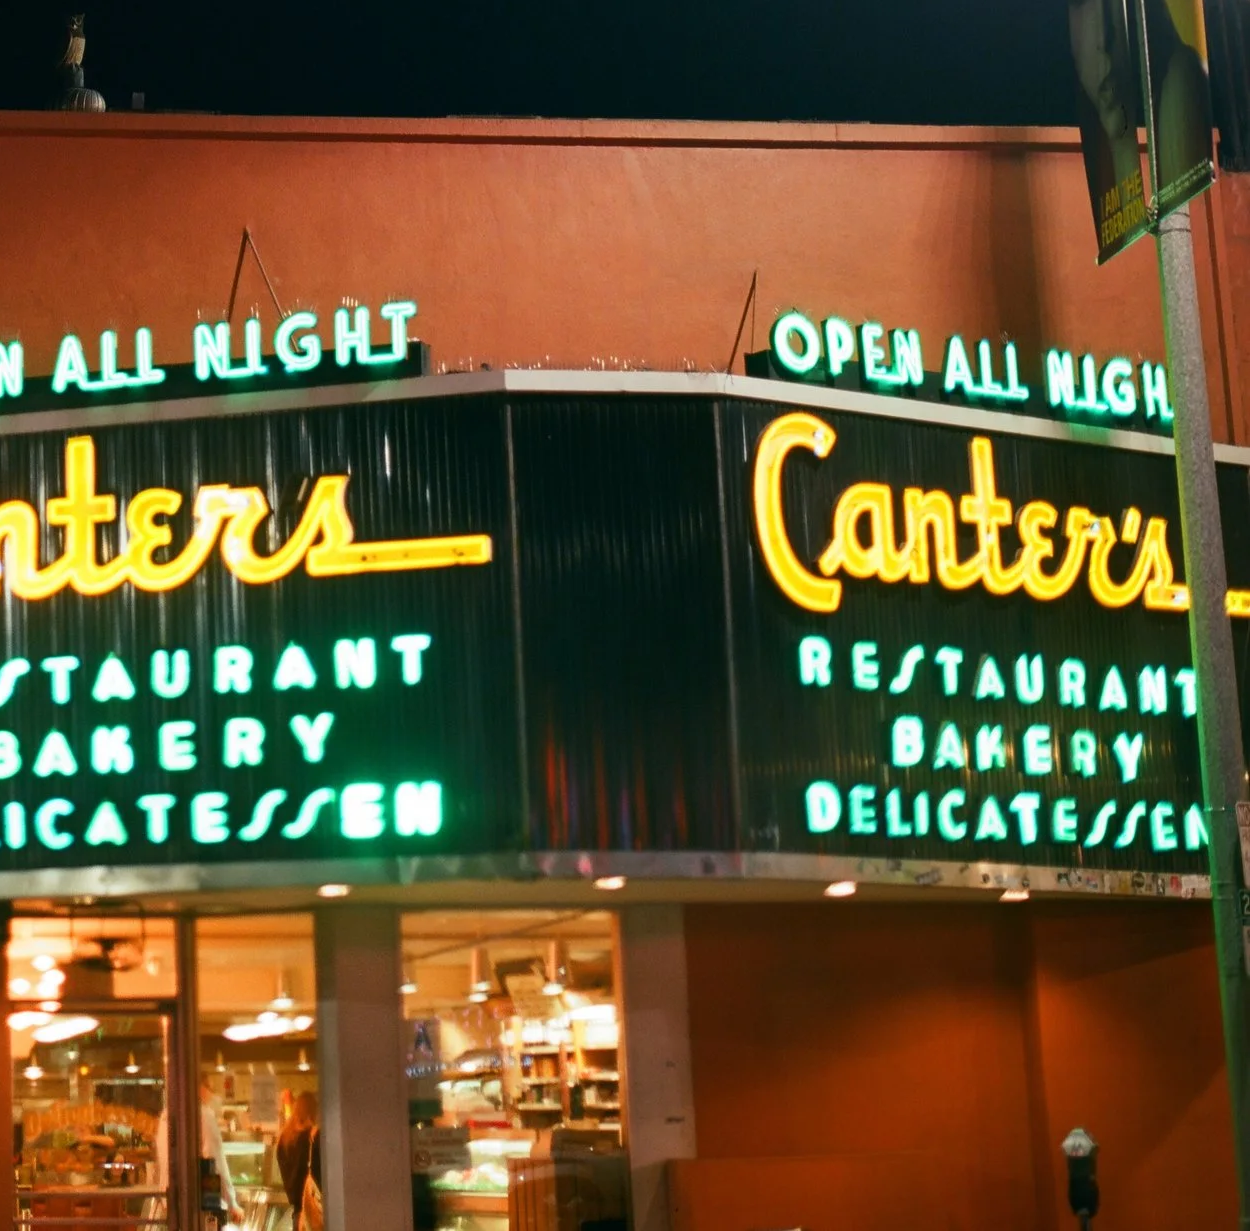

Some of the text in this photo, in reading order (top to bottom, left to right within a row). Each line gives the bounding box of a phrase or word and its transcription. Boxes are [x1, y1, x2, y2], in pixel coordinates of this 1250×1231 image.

[52, 327, 166, 393] ALL
[193, 300, 418, 381] NIGHT
[771, 311, 924, 387] OPEN
[945, 334, 1030, 401] ALL
[754, 412, 1192, 614] Canter's
[798, 635, 1197, 718] RESTAURANT
[891, 715, 1145, 783] BAKERY
